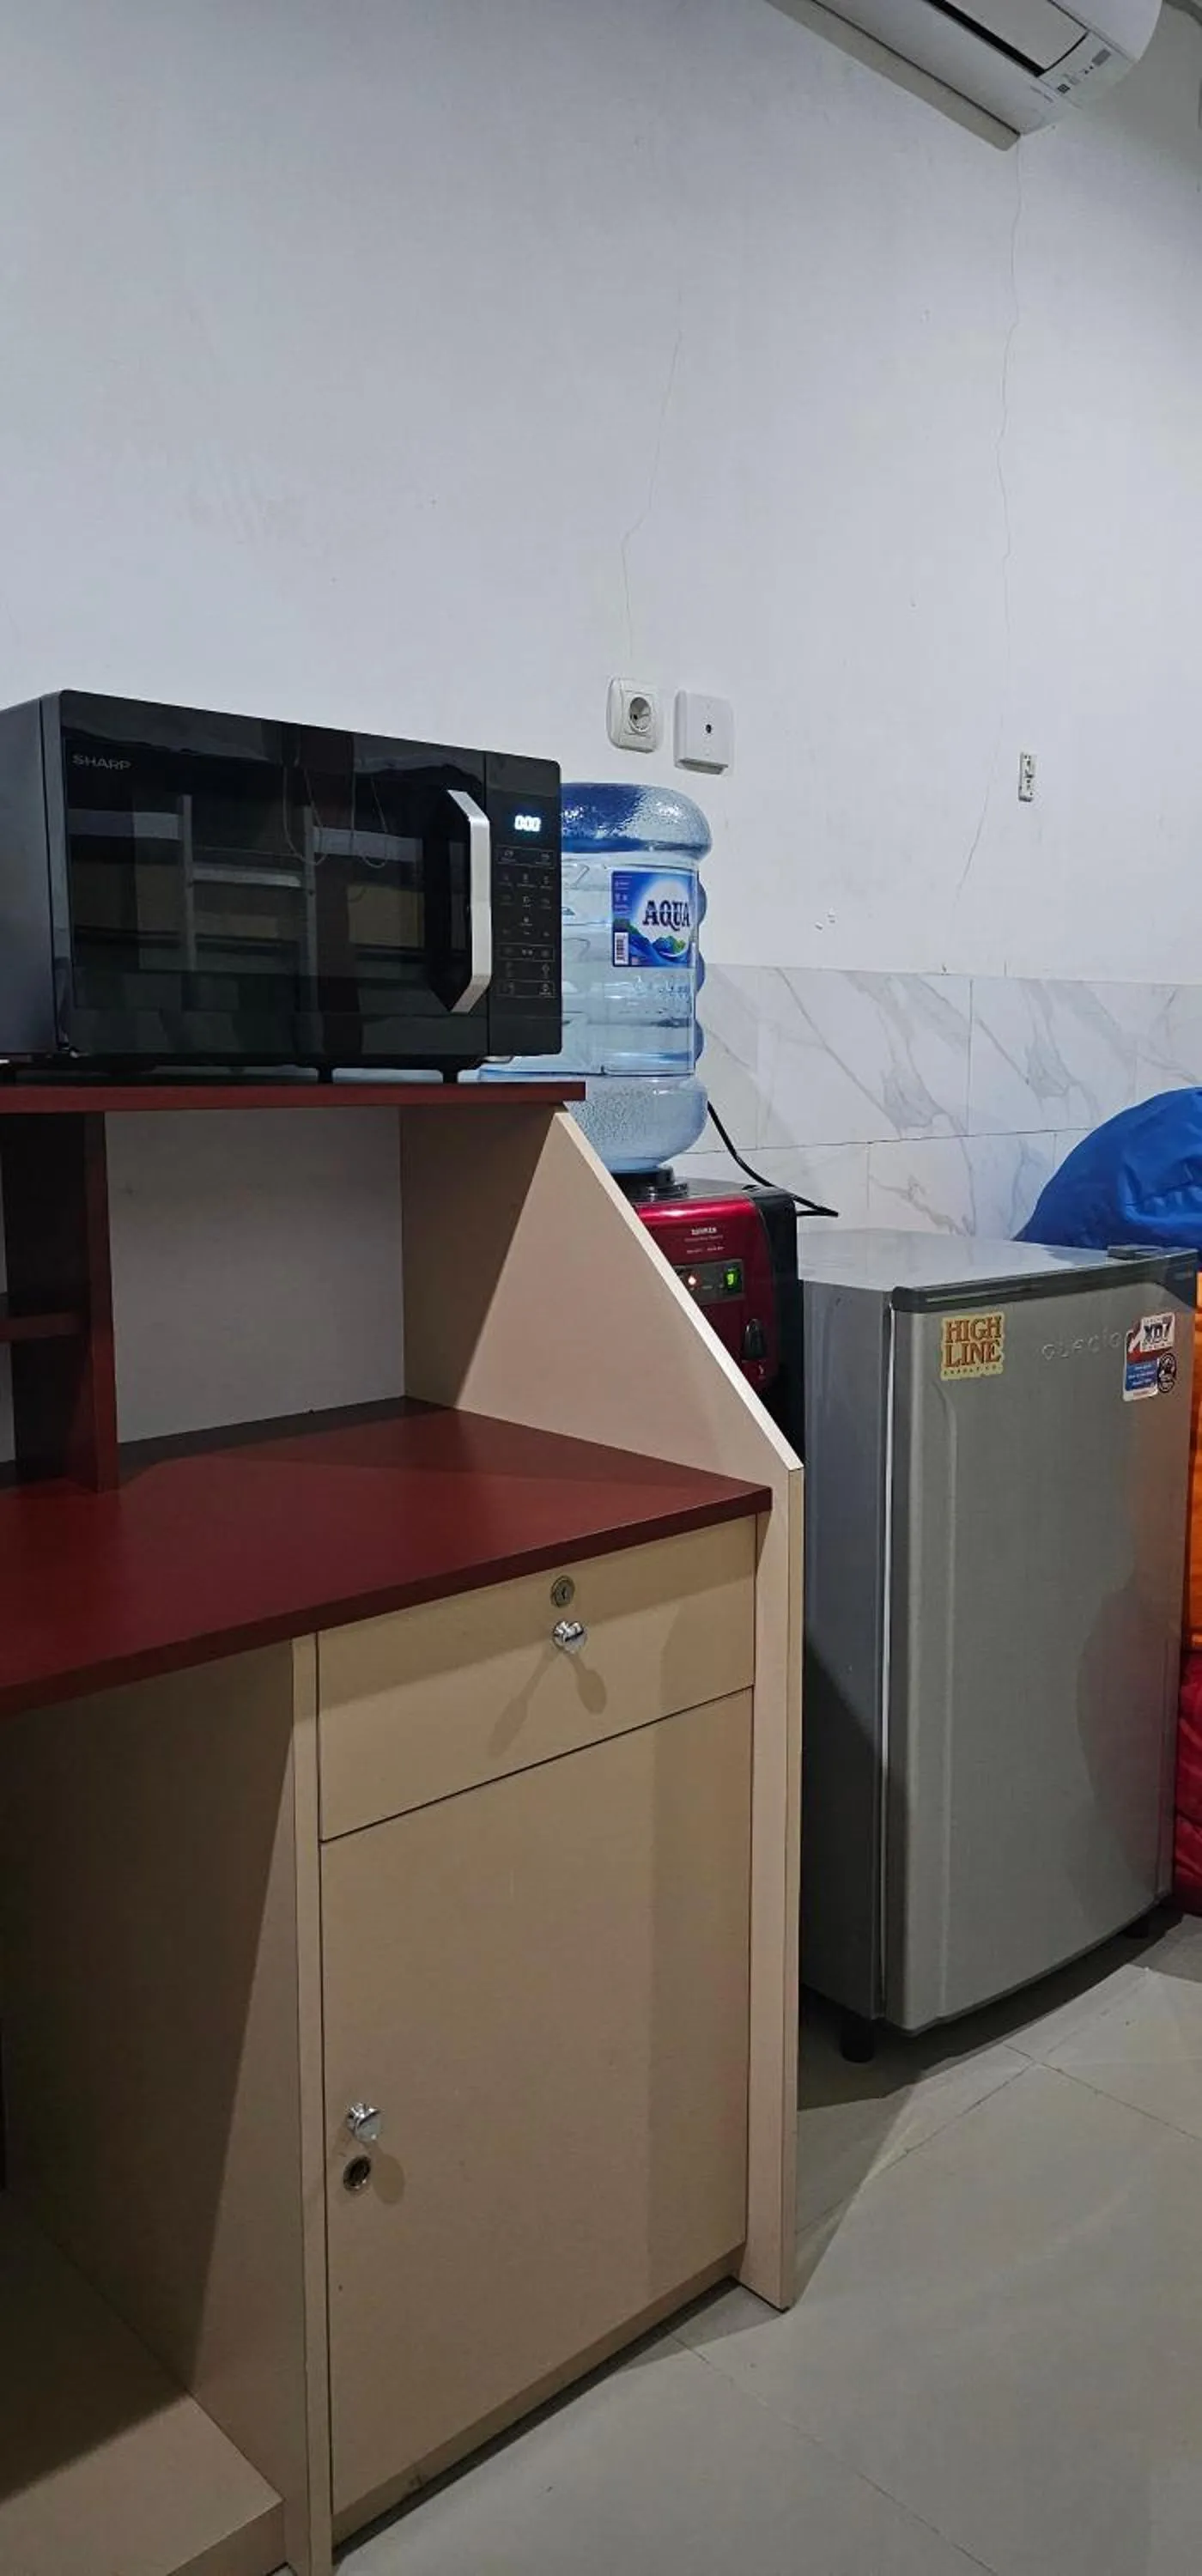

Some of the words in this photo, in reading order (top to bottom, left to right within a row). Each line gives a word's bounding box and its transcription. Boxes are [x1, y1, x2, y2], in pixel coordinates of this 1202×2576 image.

[72, 754, 131, 770] SHARP
[642, 900, 690, 932] AQUA
[945, 1316, 1002, 1343] HIGH
[945, 1340, 1001, 1367] LINE
